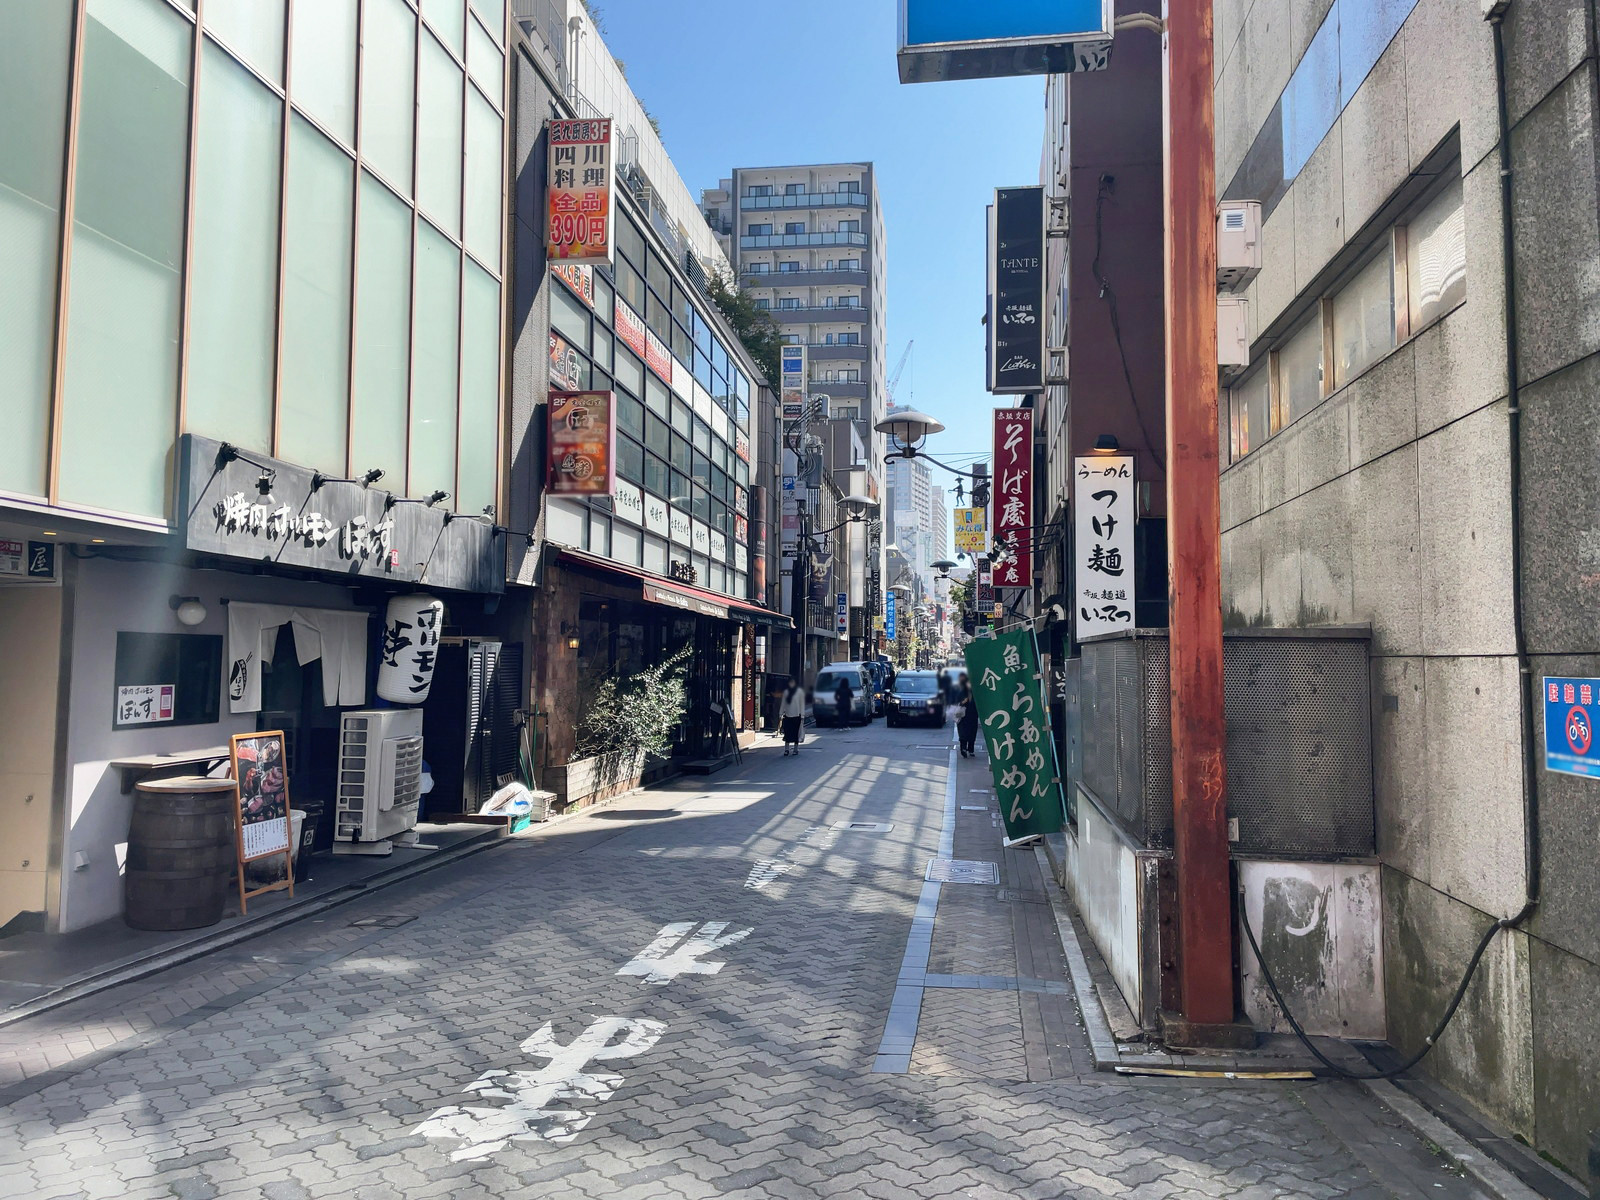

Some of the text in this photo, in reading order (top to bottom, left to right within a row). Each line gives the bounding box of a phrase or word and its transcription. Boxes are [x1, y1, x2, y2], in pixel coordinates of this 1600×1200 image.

[555, 145, 604, 166] 四川
[554, 168, 605, 188] 料理
[556, 192, 601, 212] 全品
[551, 214, 606, 245] 390円
[1001, 258, 1039, 268] TANTE
[1003, 312, 1036, 324] いってつ
[1078, 464, 1131, 479] らーめん
[223, 491, 268, 530] 焼肉
[1087, 490, 1124, 577] つけ麺
[30, 546, 50, 572] 屋
[1083, 589, 1128, 601] 赤坂麺道
[1081, 604, 1132, 623] いってつ
[408, 604, 441, 694] ホルモン
[1548, 683, 1600, 705] 駐輪禁
